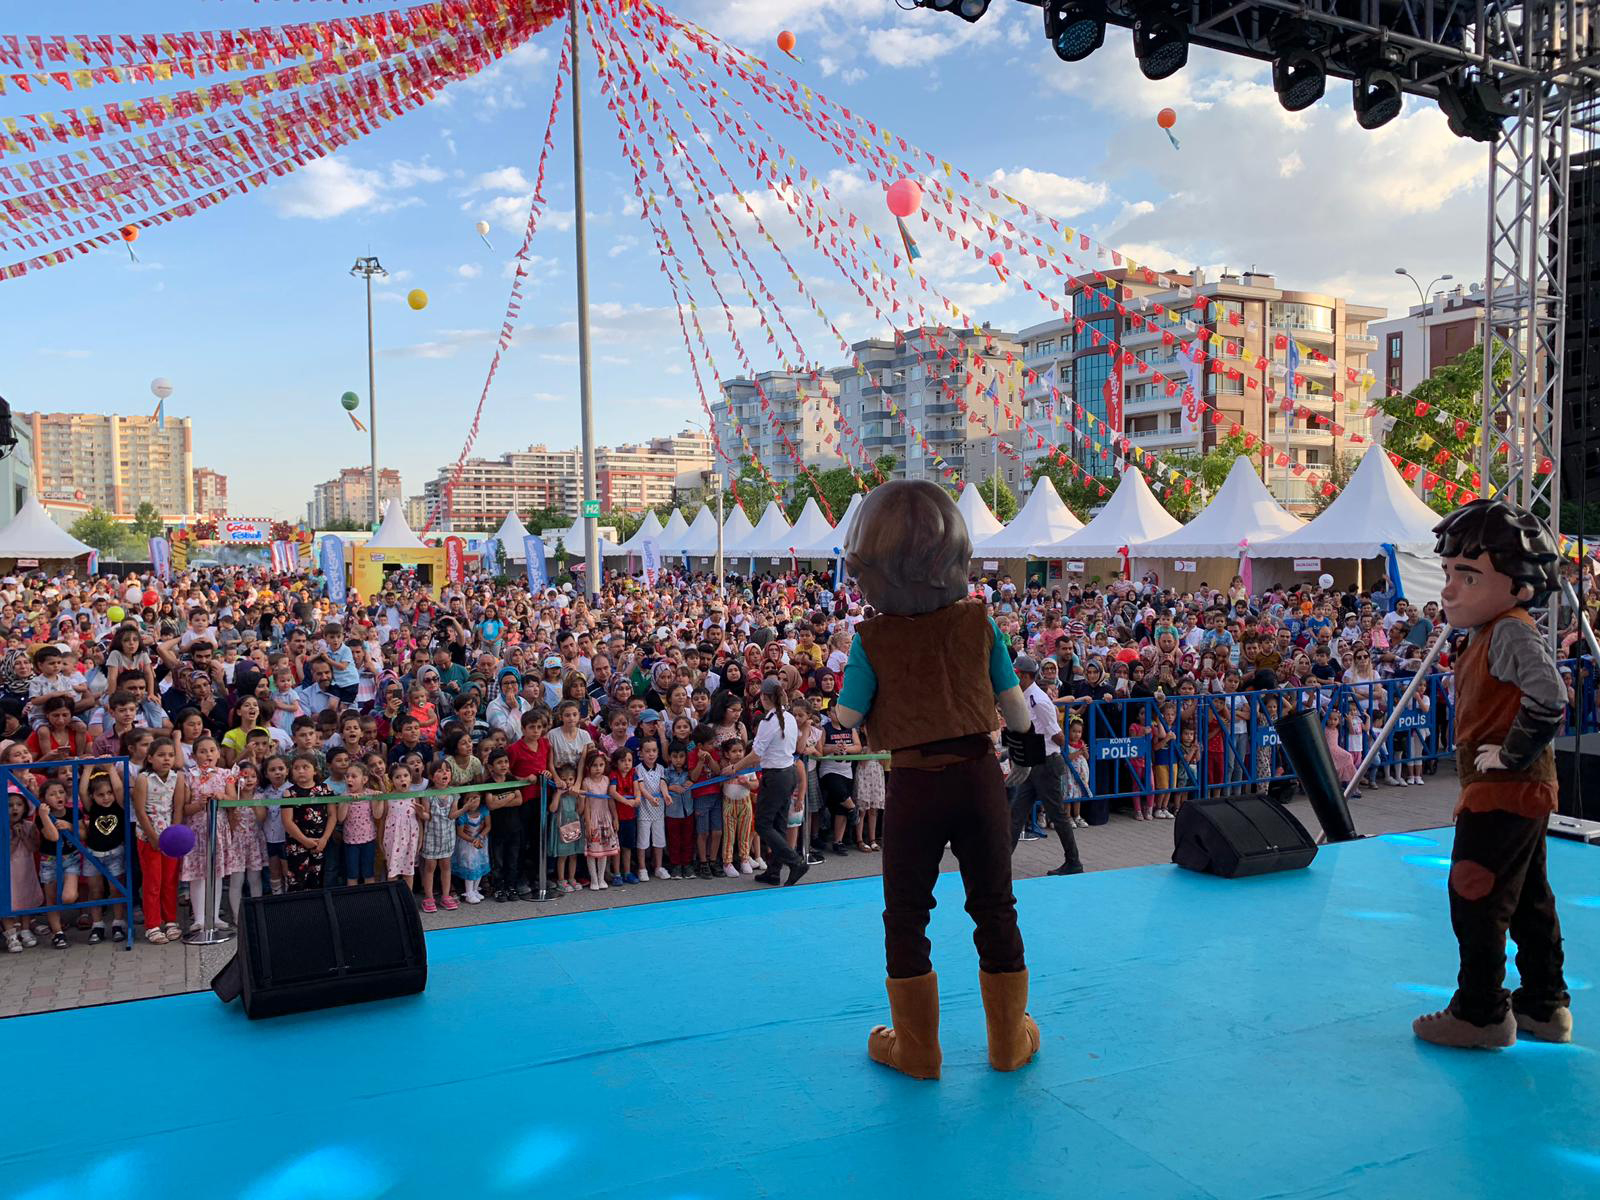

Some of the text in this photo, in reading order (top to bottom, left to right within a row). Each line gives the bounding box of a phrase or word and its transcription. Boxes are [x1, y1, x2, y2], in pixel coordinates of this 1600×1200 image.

[1135, 21, 1142, 29] 6
[1274, 58, 1280, 66] 7
[586, 504, 599, 514] H2
[1398, 713, 1426, 728] POLİS
[1262, 733, 1282, 746] POL
[1101, 743, 1138, 759] POLİS
